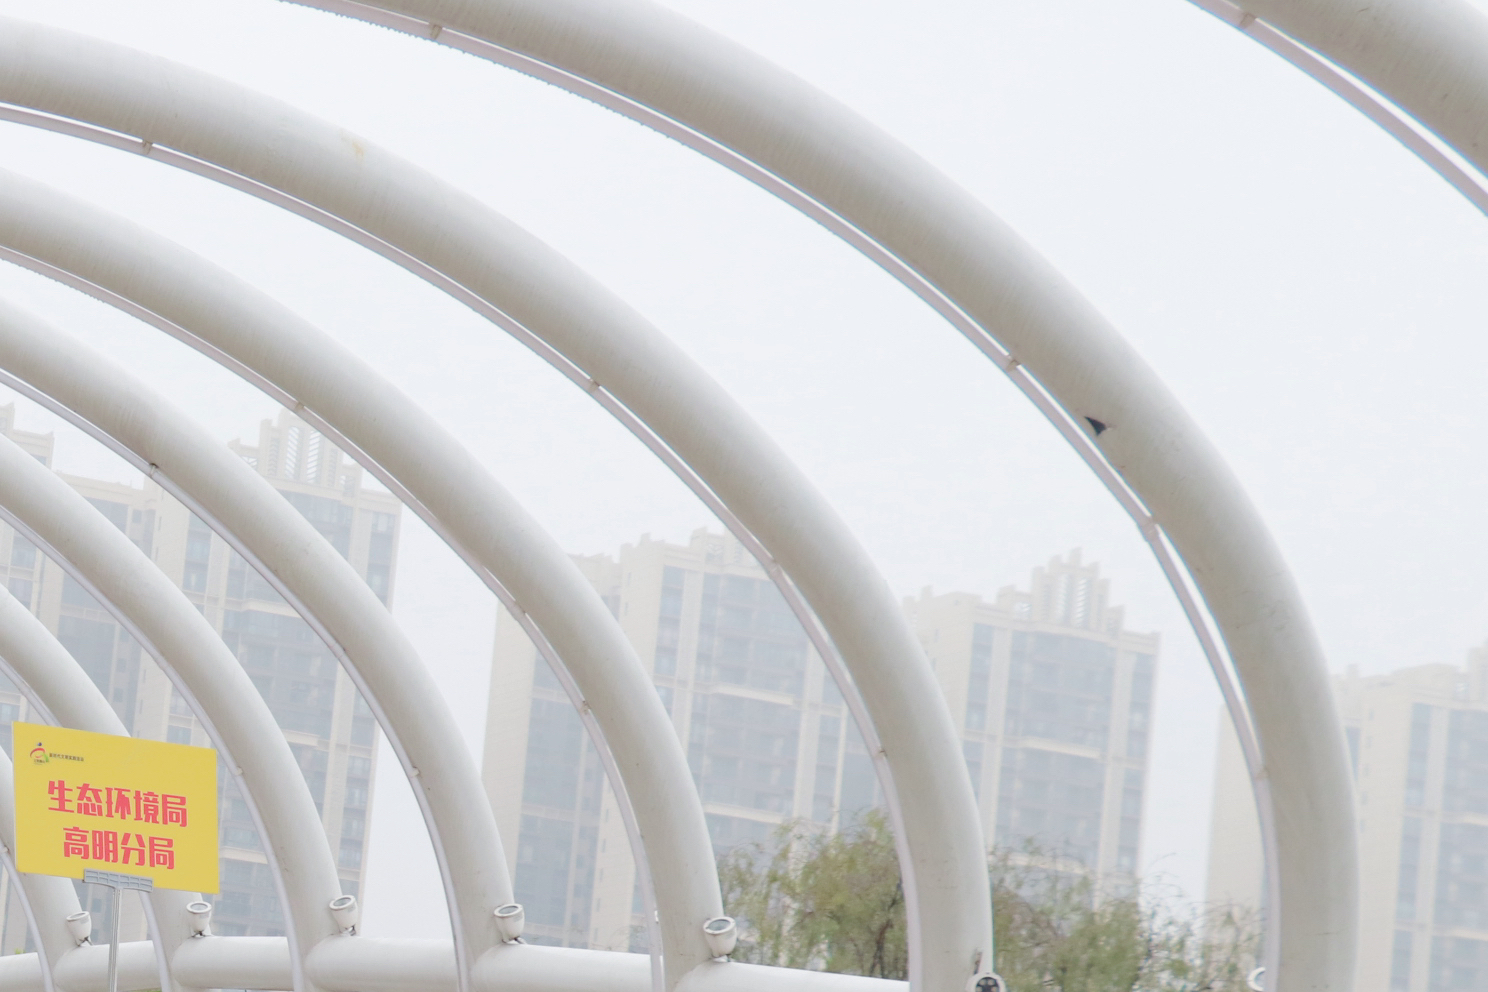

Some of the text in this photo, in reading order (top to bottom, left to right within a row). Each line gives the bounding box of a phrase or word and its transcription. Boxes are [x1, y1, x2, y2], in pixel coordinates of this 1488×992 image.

[48, 779, 188, 827] 生态环境局
[62, 826, 175, 869] 高明分局
